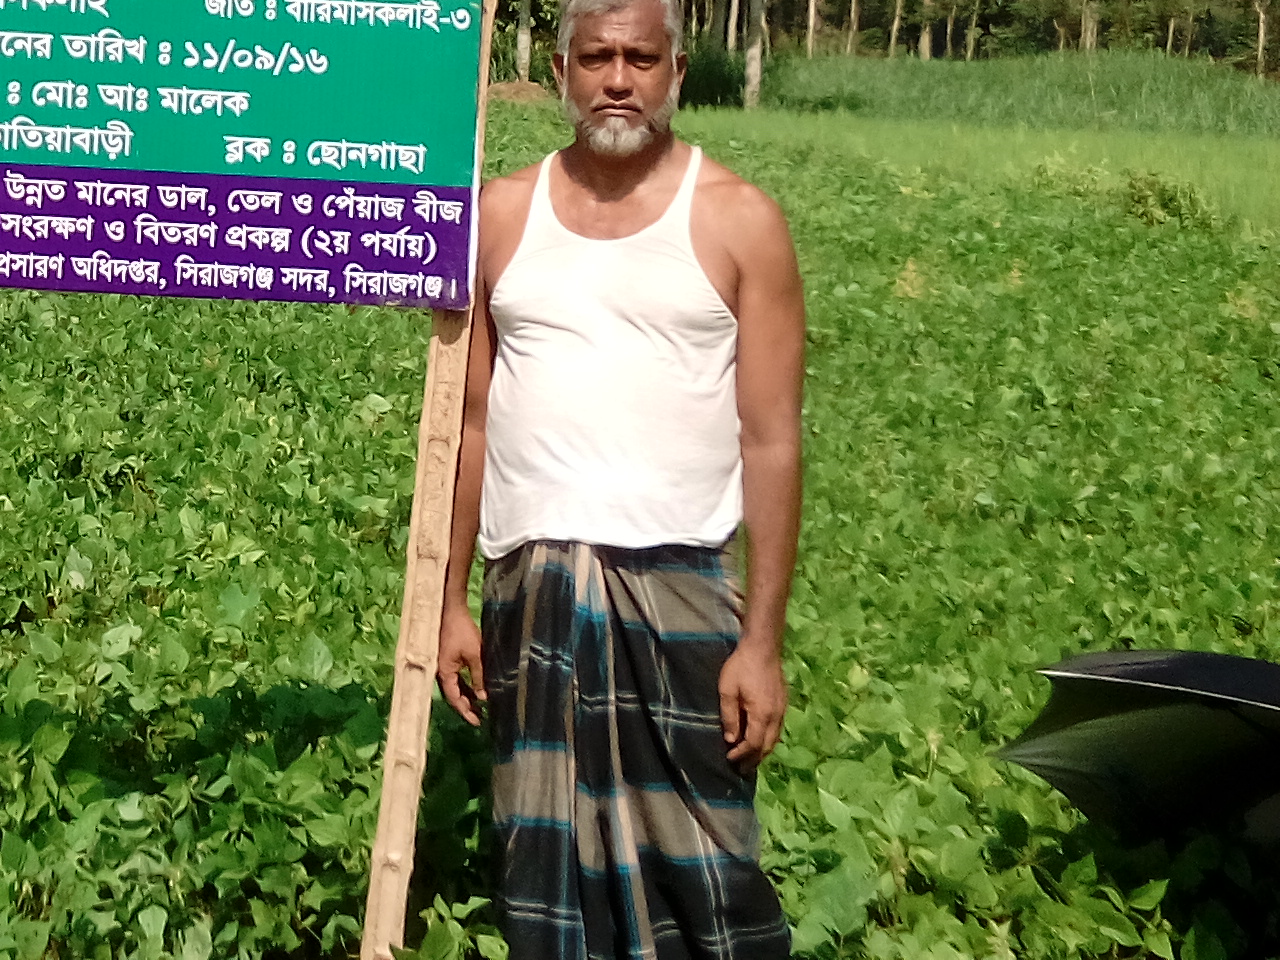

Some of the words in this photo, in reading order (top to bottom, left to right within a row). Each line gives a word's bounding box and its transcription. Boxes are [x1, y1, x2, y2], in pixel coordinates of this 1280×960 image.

[61, 28, 148, 64] তারিখ
[183, 39, 329, 76] ১১/০৯/১৬
[157, 86, 252, 117] মালেক
[223, 135, 272, 165] ব্লক
[306, 138, 428, 175] ছোনগাছা
[3, 170, 68, 209] উন্নত
[74, 180, 150, 208] মানের
[157, 183, 217, 217] ডাল,
[227, 188, 284, 215] তেল
[291, 193, 314, 216] ও
[323, 186, 406, 222] পেঁয়াজ
[412, 191, 465, 225] বীজ
[103, 219, 126, 242] ও
[133, 213, 219, 248] বিতরণ
[225, 222, 293, 253] প্রকল্প
[300, 225, 352, 259] (২য়
[70, 250, 168, 290] অধিদপ্তর,
[174, 254, 275, 290] সিরাজগঞ্জ
[280, 266, 337, 299] সদর,
